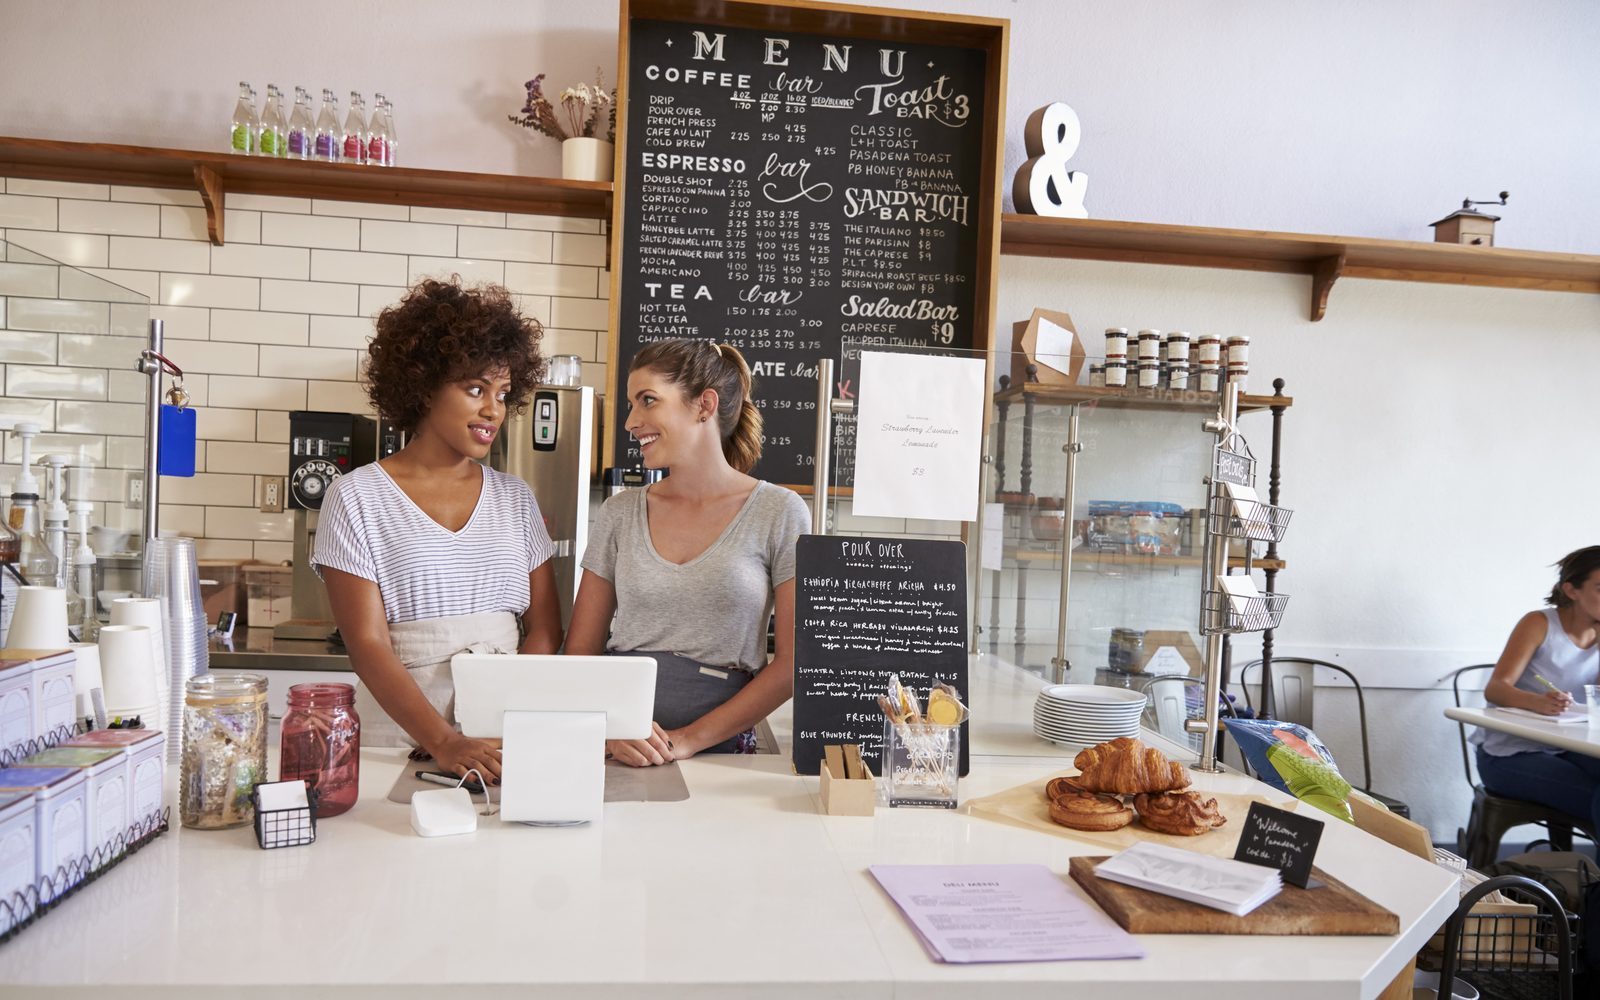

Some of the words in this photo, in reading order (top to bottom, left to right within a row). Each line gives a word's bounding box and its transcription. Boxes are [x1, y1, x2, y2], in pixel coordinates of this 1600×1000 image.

[692, 31, 907, 77] MENU
[646, 65, 751, 88] COFFEE
[769, 72, 823, 93] bar
[812, 97, 854, 106] ICED/BLENDED
[855, 75, 953, 116] Toast
[650, 95, 674, 105] DRIP
[761, 104, 778, 112] 2.00
[785, 106, 806, 114] 2.30
[649, 107, 674, 115] POUR
[675, 107, 702, 116] OVER
[761, 113, 775, 123] MP
[647, 116, 685, 126] FRENCH
[688, 118, 716, 127] PRESS
[785, 124, 807, 133] 4.25
[851, 125, 912, 137] CLASSIC
[646, 128, 671, 137] CAFE
[673, 129, 687, 138] AU
[690, 130, 712, 138] LAIT
[646, 139, 672, 147] COLD
[676, 139, 706, 148] BREW
[851, 138, 875, 148] L+H
[879, 140, 918, 149] TOAST
[642, 152, 746, 173] ESPRESSO
[850, 150, 910, 161] PASADENA
[914, 152, 952, 163] TOAST
[848, 164, 862, 175] PB
[866, 165, 904, 177] HONEY
[907, 168, 954, 180] BANANA
[644, 174, 684, 185] DOUBLE
[687, 177, 713, 187] SHOT
[728, 179, 748, 188] 2.25
[895, 179, 908, 189] PB
[921, 181, 963, 193] BANANA
[642, 185, 681, 194] ESPRESSO
[682, 187, 697, 195] CON
[697, 187, 726, 197] PANNA
[642, 195, 690, 204] CORTADO
[642, 205, 708, 215] CAPPUCCINO
[779, 210, 800, 219] 3.75
[843, 188, 970, 226] SANDWICH
[880, 207, 935, 223] BAR
[642, 215, 677, 223] LATTE
[809, 222, 831, 231] 3.75
[641, 223, 686, 235] HONEYBEE
[687, 227, 716, 236] LATTE
[726, 229, 748, 238] 3.75
[844, 224, 863, 233] THE
[866, 225, 912, 236] ITALIANO
[919, 228, 946, 238] $8.50
[640, 234, 667, 245] SALTED
[667, 236, 700, 247] CARAMEL
[701, 239, 723, 248] LATTE
[844, 236, 861, 245] THE
[865, 238, 910, 248] PARISIAN
[919, 240, 931, 250] $8
[639, 246, 667, 256] FRENCH
[667, 248, 701, 259] LAVENDER
[704, 251, 724, 259] BREVE
[844, 248, 861, 257] THE
[865, 250, 908, 260] CAPRESE
[919, 251, 931, 262] $9
[641, 257, 676, 266] MOCHA
[873, 259, 902, 268] $8.50
[640, 266, 701, 278] AMERICANO
[841, 269, 884, 280] SRIRACHA
[886, 272, 916, 281] ROAST
[918, 273, 941, 281] BEEF
[645, 283, 712, 301] TEA
[739, 285, 803, 305] bar
[841, 280, 872, 289] DESIGN
[873, 281, 895, 290] YOUR
[896, 283, 916, 291] OWN
[921, 283, 935, 294] $8
[639, 304, 661, 313] HOT
[665, 304, 686, 313] TEA
[776, 308, 797, 316] 2.00
[841, 295, 917, 319] Salad
[917, 300, 960, 321] Bar
[639, 315, 666, 324] ICED
[667, 315, 687, 324] TEA
[800, 319, 822, 327] 3.00
[639, 325, 661, 334] TEA
[664, 326, 699, 335] LATTE
[725, 328, 748, 336] 2.00
[750, 329, 769, 337] 2.35
[776, 329, 795, 338] 2.70
[841, 323, 897, 333] CAPRESE
[931, 321, 955, 344] $9
[799, 341, 821, 349] 3.75
[841, 335, 890, 346] CHOPPED
[889, 337, 927, 348] ITALIAN
[796, 402, 816, 410] 3.50
[881, 423, 923, 434] Strawberry
[771, 437, 791, 445] 3.25
[842, 541, 872, 557] POUR
[878, 543, 904, 558] OVER
[803, 577, 839, 588] ETHIOPIA
[933, 583, 956, 591] $4.50
[830, 619, 848, 628] RICA
[938, 626, 959, 634] $4.25
[799, 667, 835, 675] SUMATRA
[841, 670, 875, 678] LINTONG
[900, 671, 929, 679] BATAK
[935, 672, 958, 680] $4.15
[846, 713, 883, 722] FRENCH
